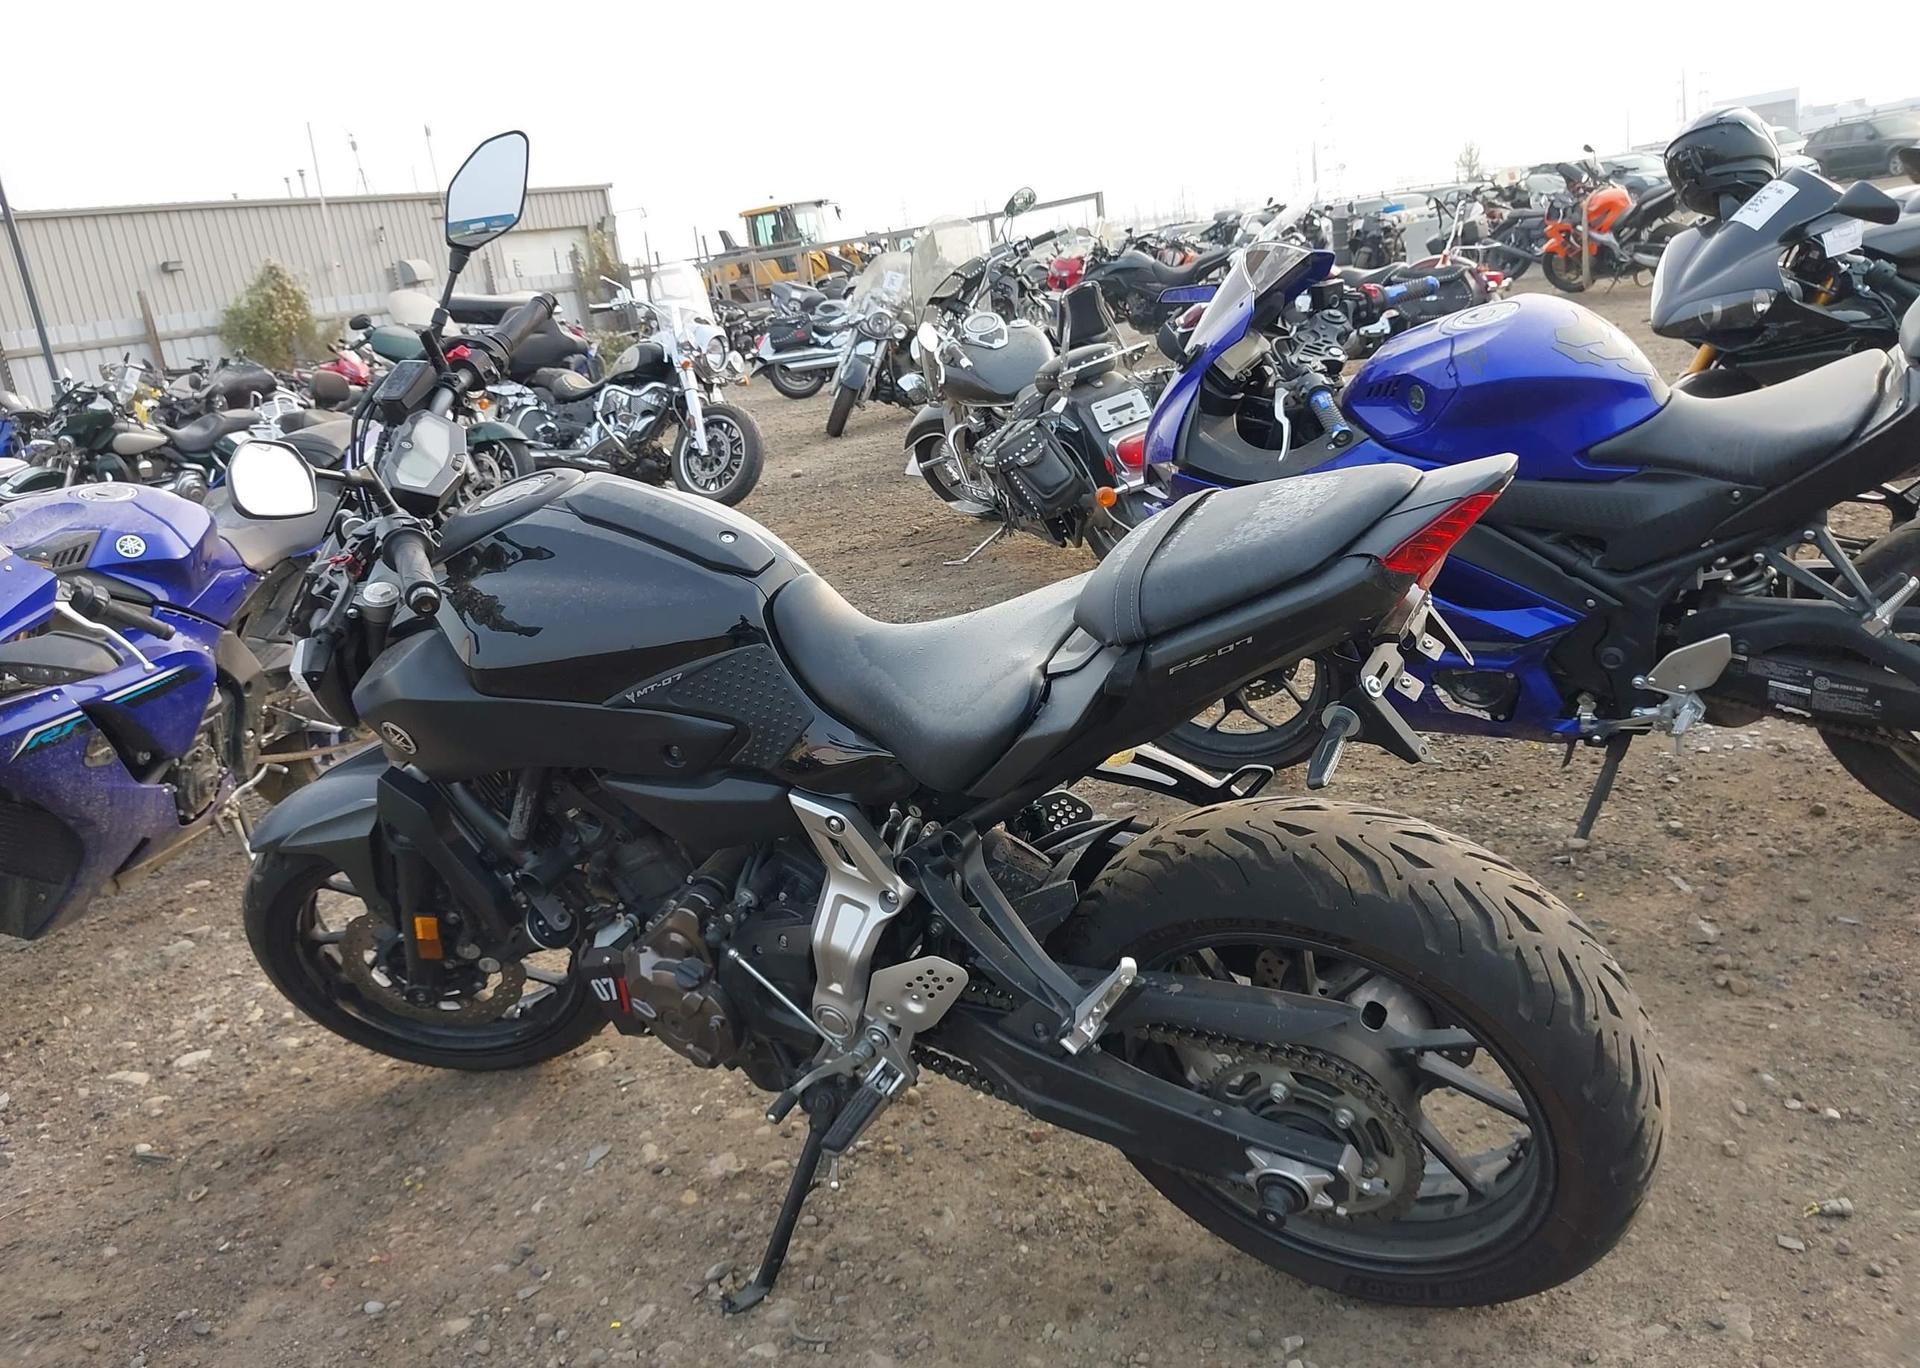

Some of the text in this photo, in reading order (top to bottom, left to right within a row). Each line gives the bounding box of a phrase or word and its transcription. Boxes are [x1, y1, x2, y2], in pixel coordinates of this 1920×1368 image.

[1168, 635, 1254, 676] FZ-07
[636, 672, 683, 698] MT-07
[590, 976, 618, 1002] 07
